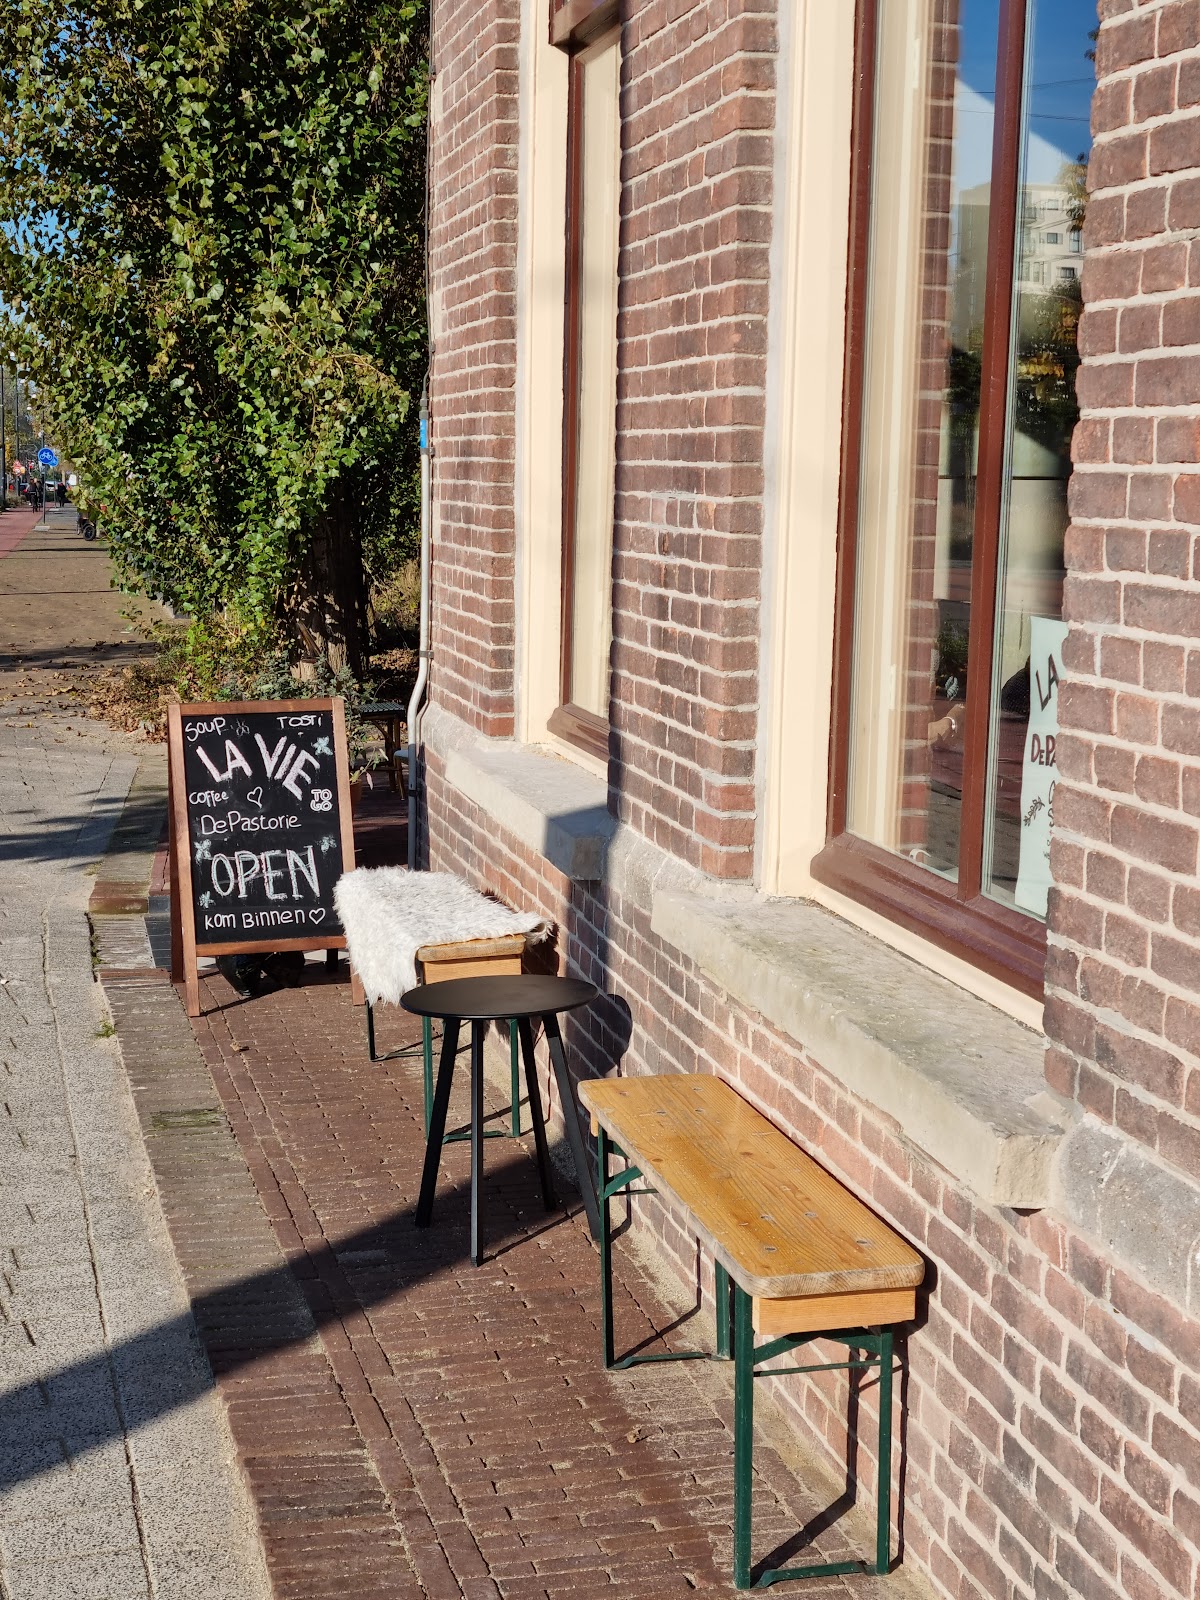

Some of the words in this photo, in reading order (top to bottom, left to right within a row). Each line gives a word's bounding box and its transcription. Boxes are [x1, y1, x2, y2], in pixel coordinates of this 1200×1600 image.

[1036, 653, 1059, 711] LA
[196, 739, 253, 783] LA
[254, 733, 321, 801] VIE
[310, 799, 333, 811] GO
[311, 789, 332, 801] TO
[211, 845, 320, 900] OPEN
[242, 909, 306, 928] Binnen
